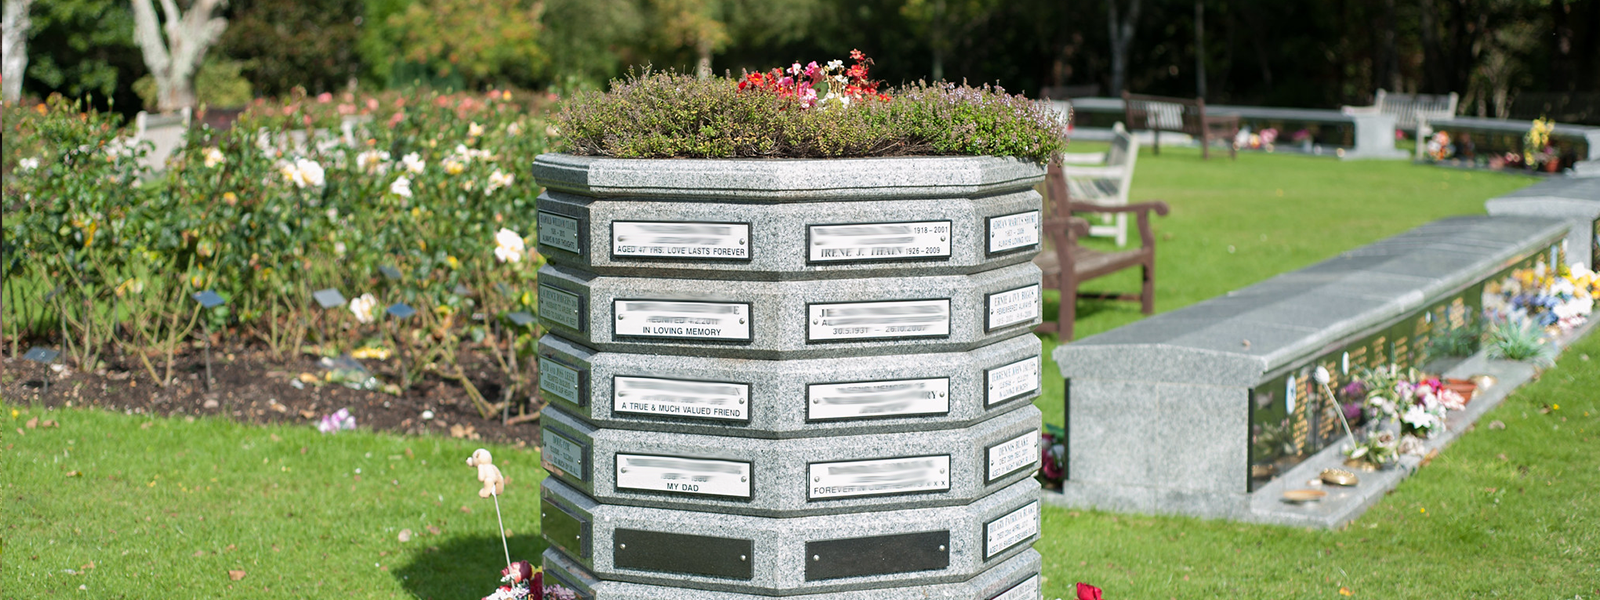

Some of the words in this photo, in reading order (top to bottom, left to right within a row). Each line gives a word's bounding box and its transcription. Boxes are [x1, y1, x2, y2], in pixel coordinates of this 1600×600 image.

[617, 245, 635, 253] AGED
[667, 246, 686, 255] LOVE
[688, 247, 710, 256] LASTS
[712, 248, 745, 256] FOREVER
[820, 248, 852, 258] IRENE
[856, 248, 865, 257] J.
[642, 326, 651, 334] IN
[653, 326, 683, 335] LOVING
[685, 327, 722, 336] MEMORY
[630, 402, 649, 411] TRUE
[659, 404, 680, 413] MUCH
[683, 406, 711, 415] VALUED
[714, 408, 741, 417] FRIEND
[666, 482, 679, 490] MY
[682, 483, 699, 492] DAD
